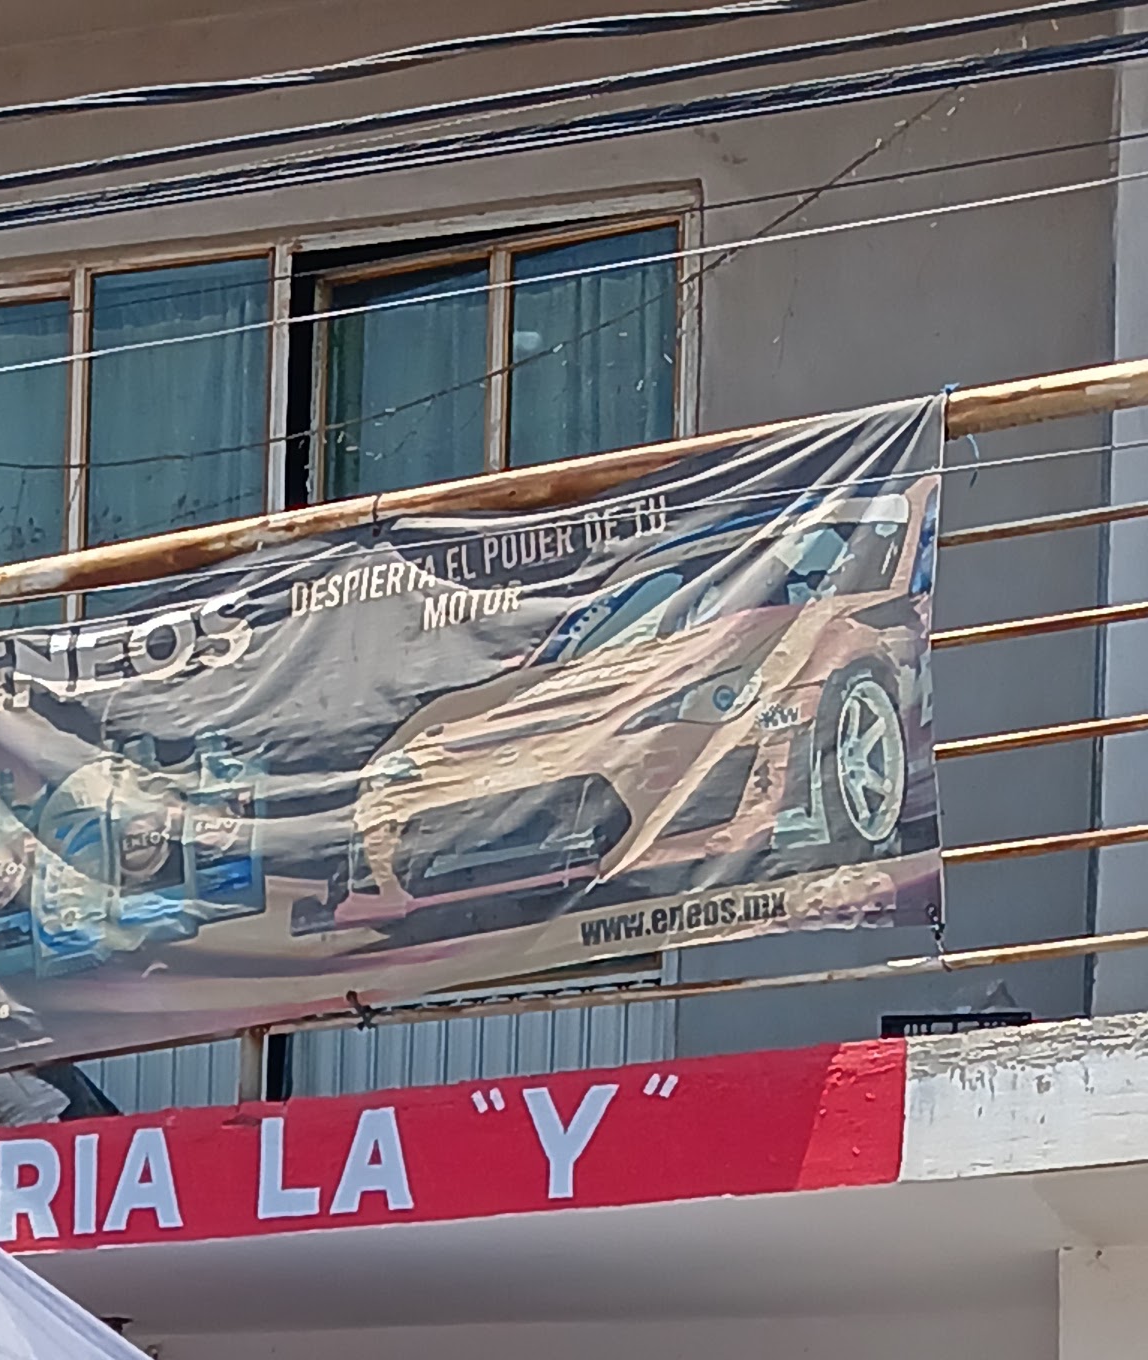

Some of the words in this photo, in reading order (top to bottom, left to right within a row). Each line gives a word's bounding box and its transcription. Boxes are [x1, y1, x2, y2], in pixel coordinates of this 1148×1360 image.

[291, 557, 437, 618] DESPIERTA
[447, 545, 476, 581] EL
[483, 528, 575, 574] PODER
[583, 509, 620, 552] DE
[634, 495, 667, 538] TU
[423, 584, 523, 631] MOTOR
[257, 1107, 415, 1220] LA
